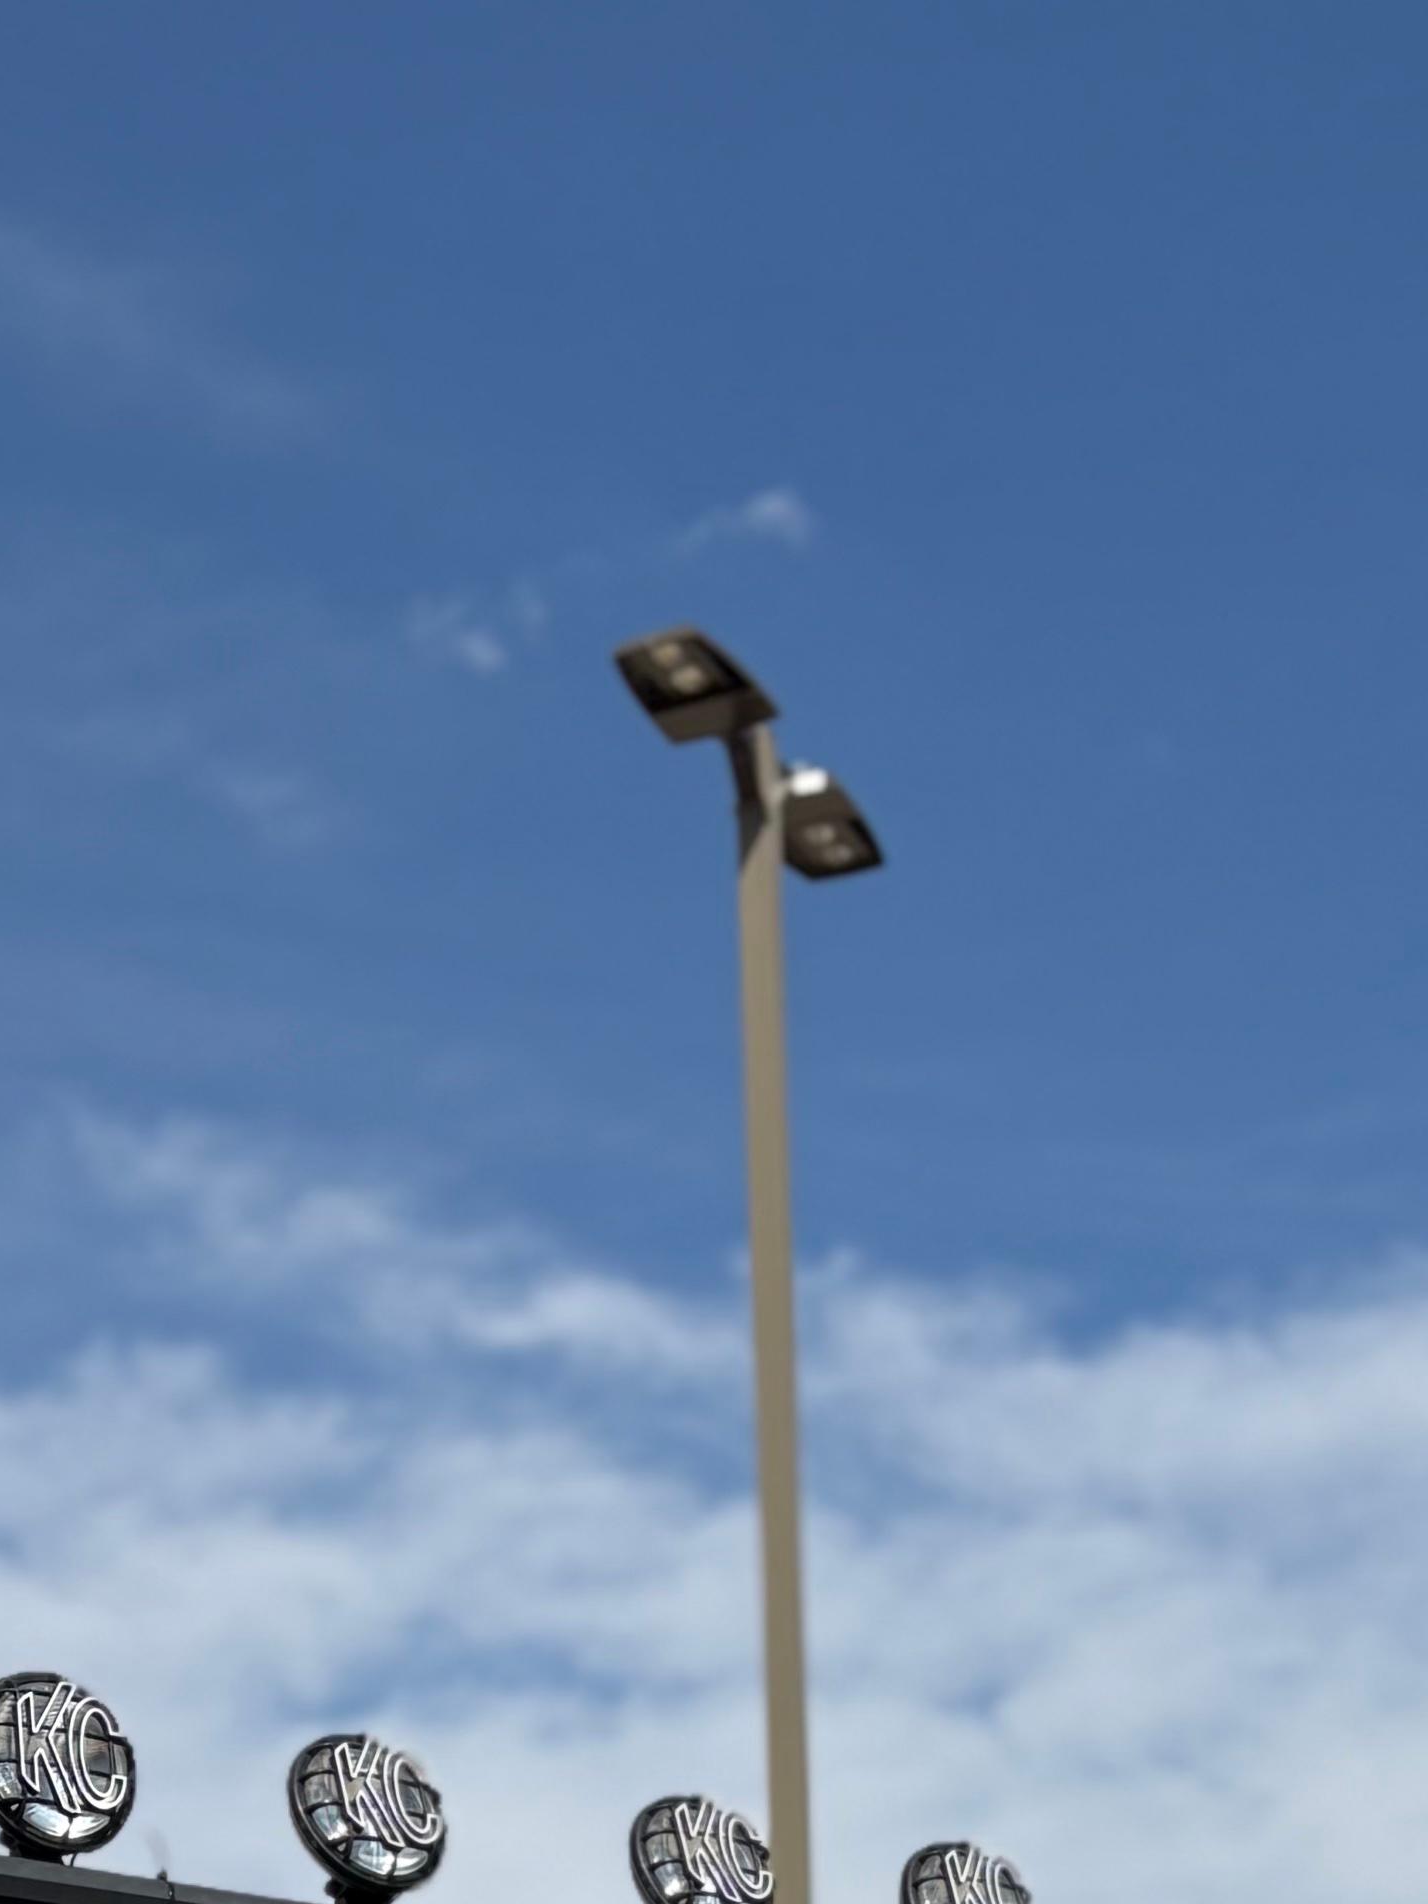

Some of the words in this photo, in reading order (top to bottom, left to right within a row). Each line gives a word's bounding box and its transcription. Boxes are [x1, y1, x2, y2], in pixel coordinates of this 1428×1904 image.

[16, 1681, 128, 1813] KC
[333, 1736, 444, 1848] KC
[674, 1799, 773, 1903] KC
